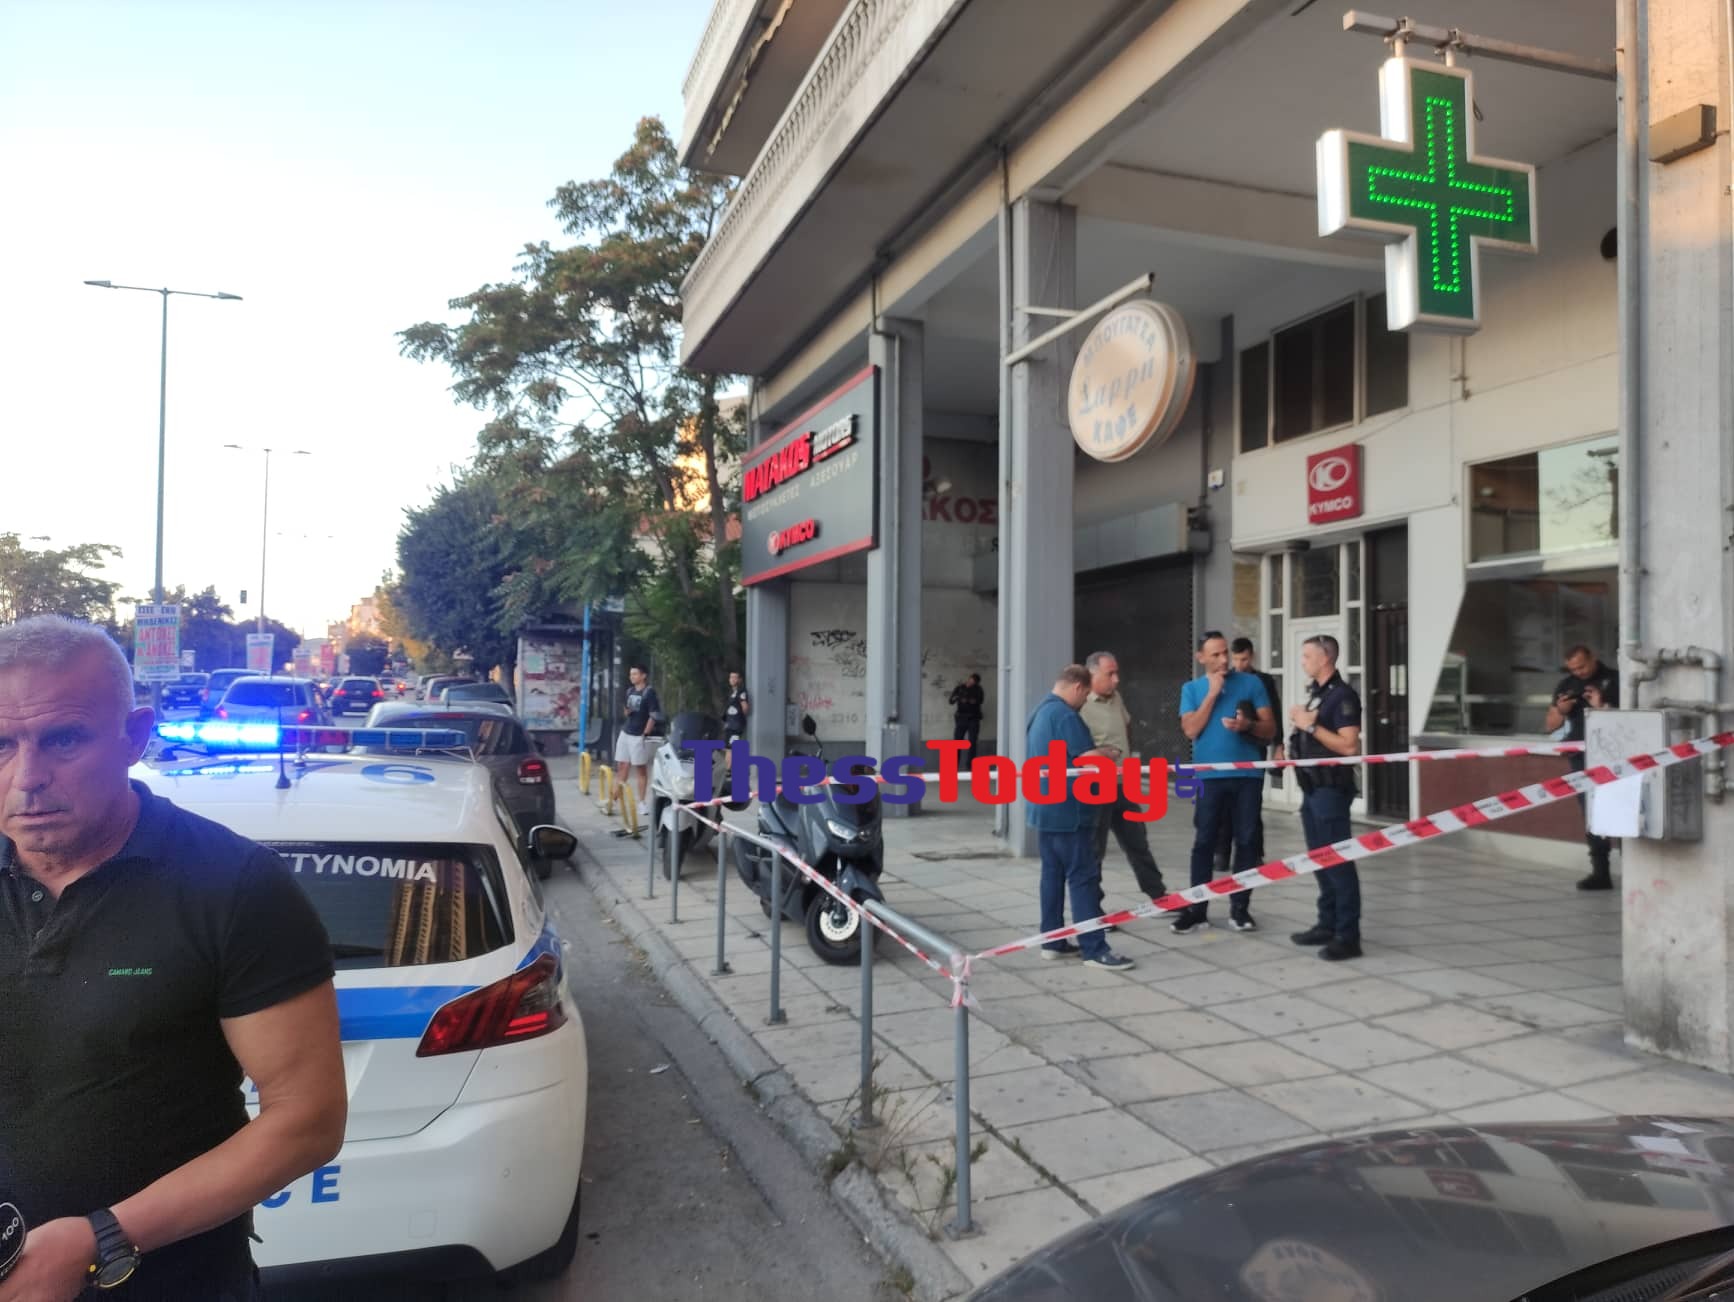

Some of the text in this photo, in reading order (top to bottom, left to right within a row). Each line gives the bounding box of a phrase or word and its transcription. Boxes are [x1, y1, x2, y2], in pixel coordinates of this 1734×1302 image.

[1309, 496, 1353, 515] KYMCO
[779, 518, 815, 549] KYMCO
[279, 853, 437, 882] ΤΥΝΟΜΙΑ
[1, 1217, 19, 1241] 100
